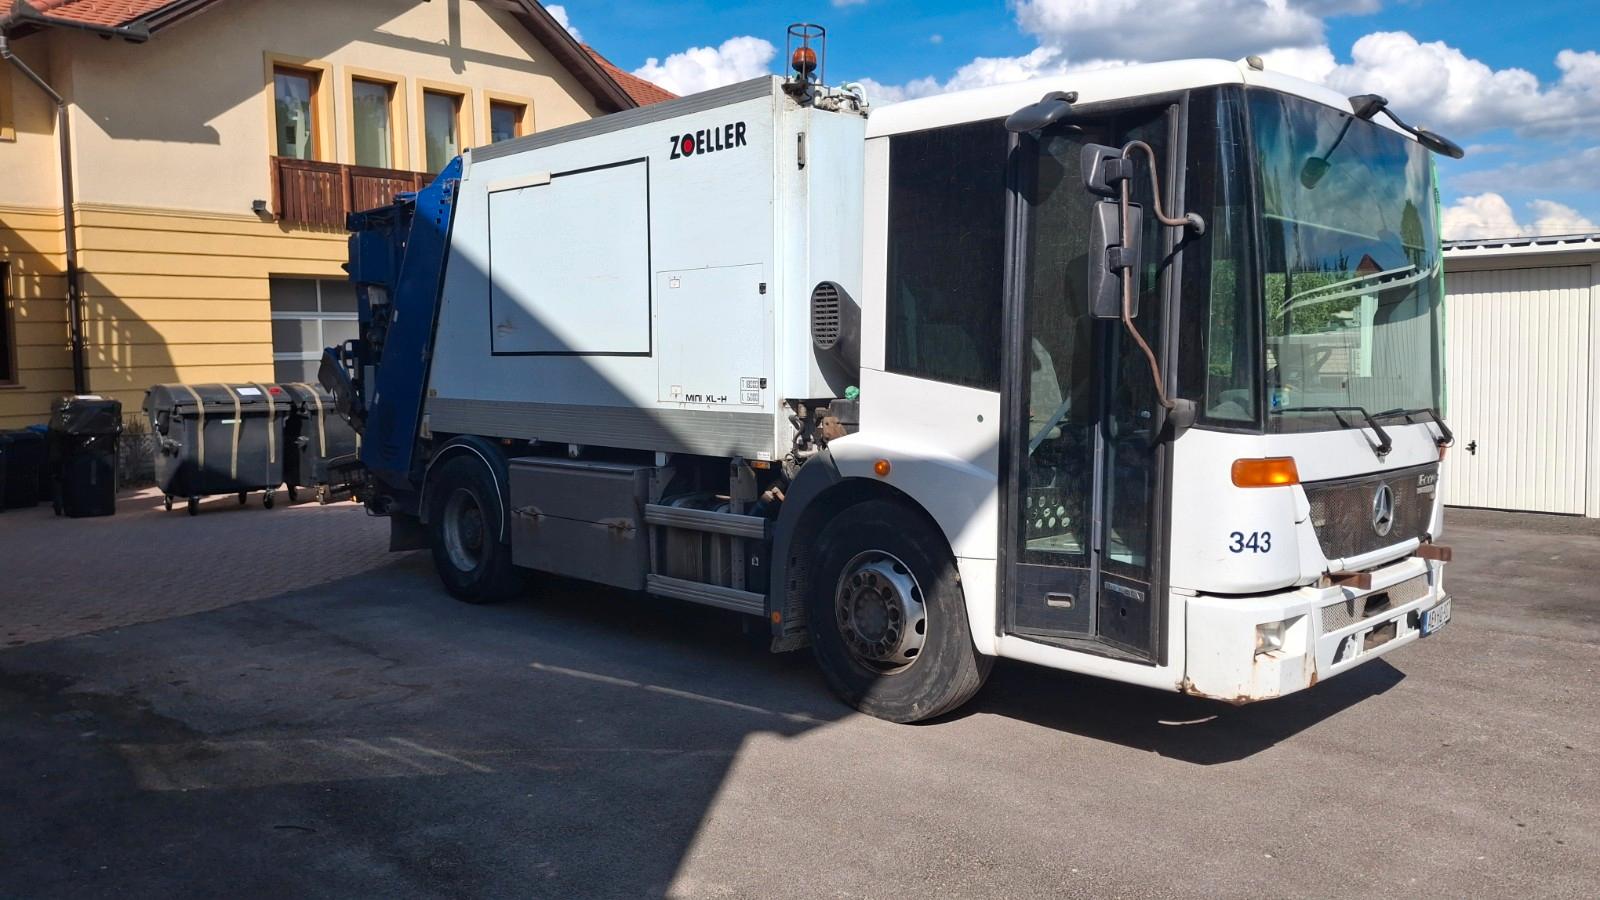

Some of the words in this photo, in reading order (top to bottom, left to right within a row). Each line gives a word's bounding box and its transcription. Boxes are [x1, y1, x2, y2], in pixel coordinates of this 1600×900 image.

[670, 121, 747, 160] ZOELLER
[706, 394, 727, 403] XL-H
[1229, 531, 1271, 553] 343
